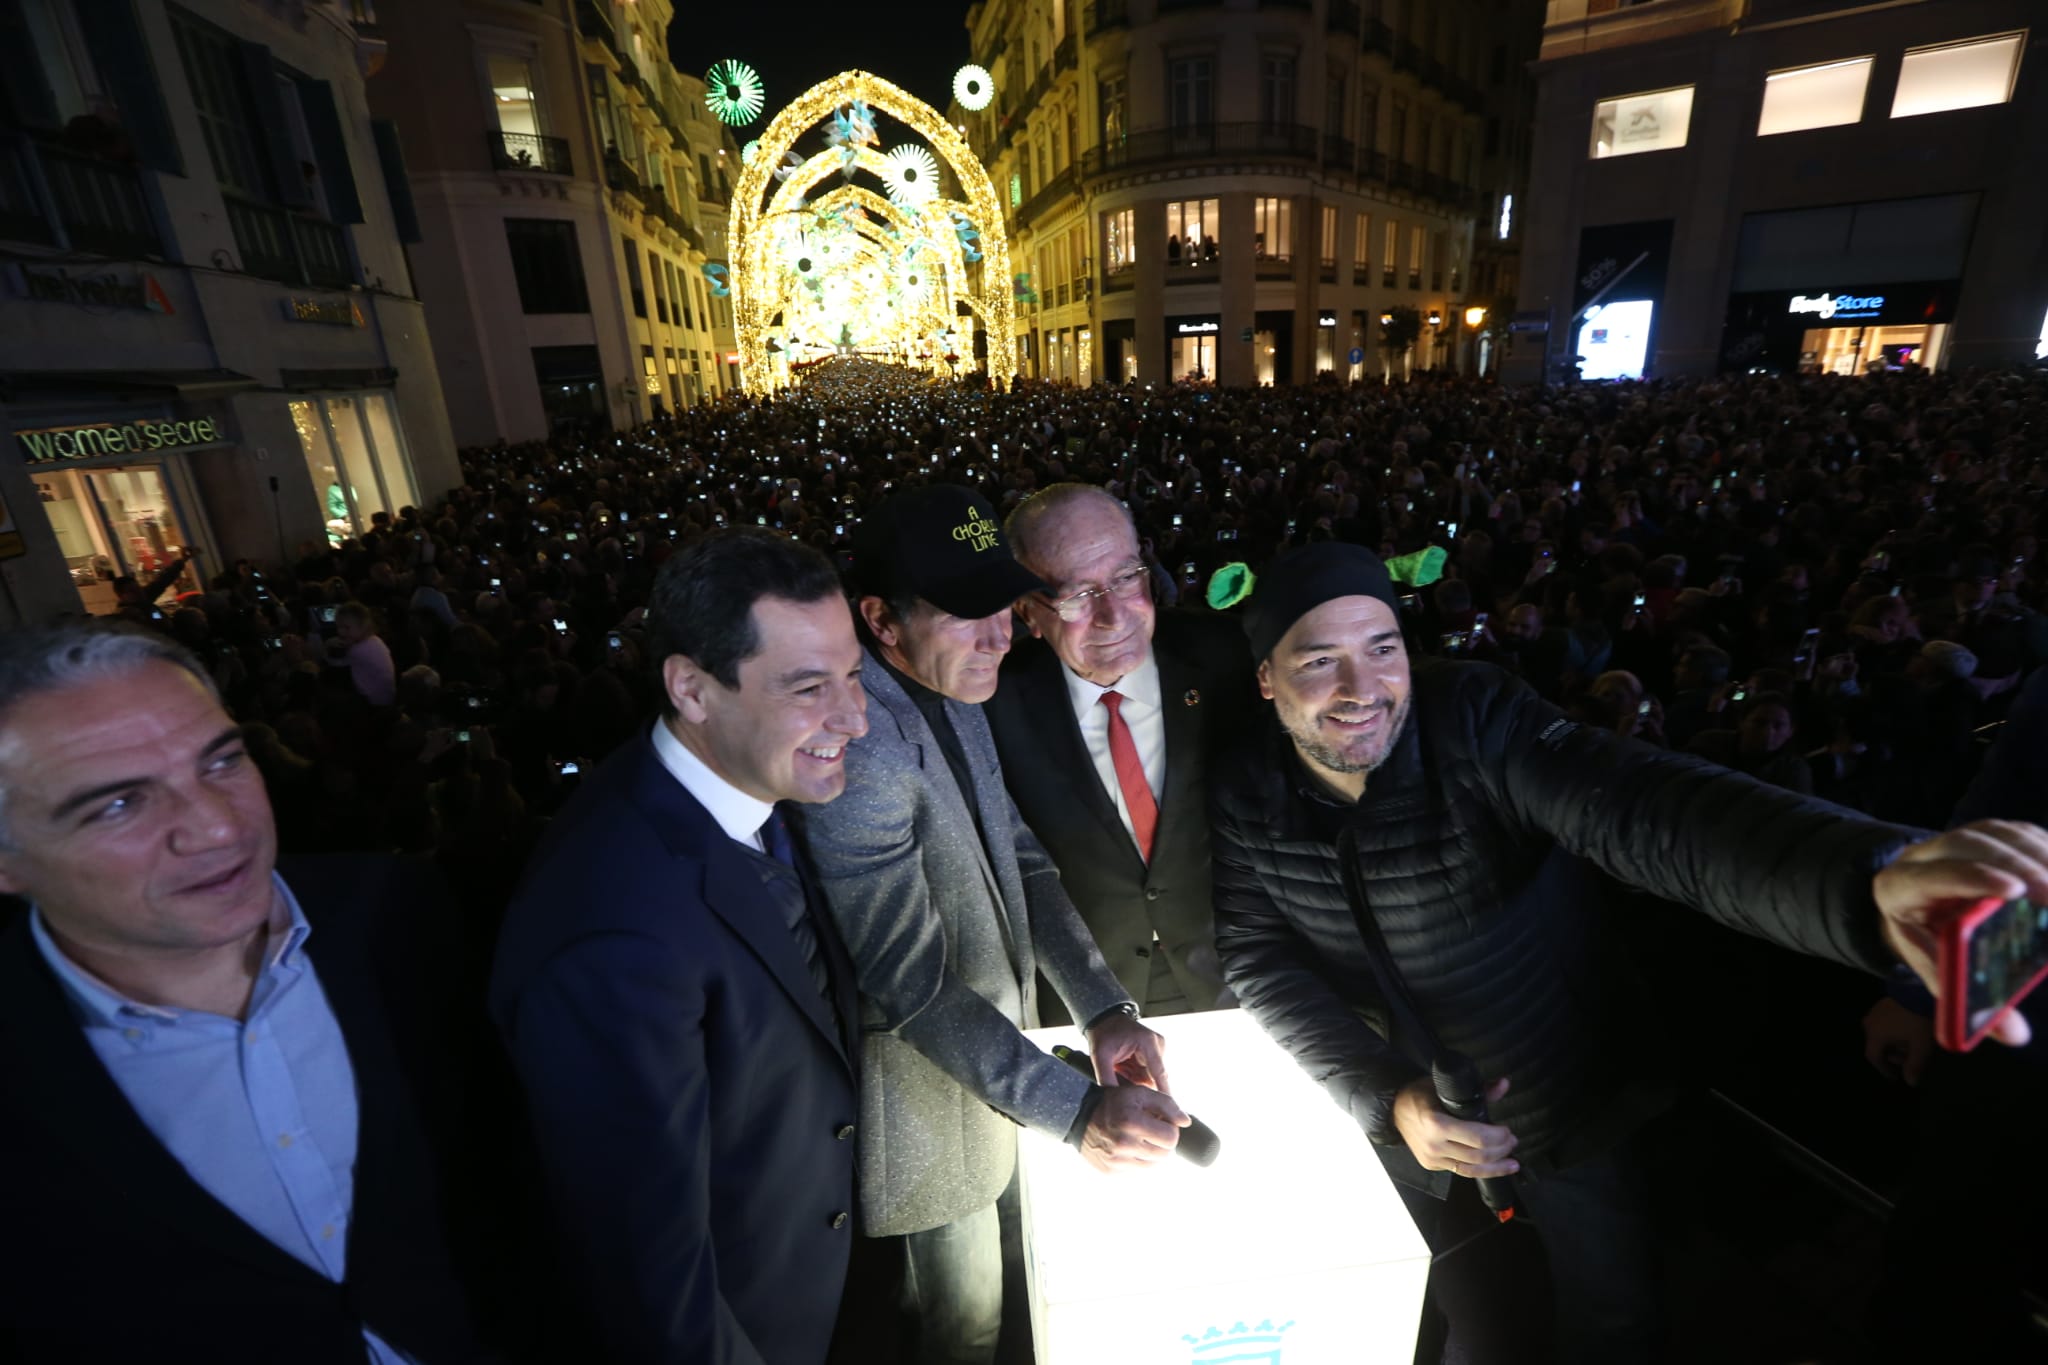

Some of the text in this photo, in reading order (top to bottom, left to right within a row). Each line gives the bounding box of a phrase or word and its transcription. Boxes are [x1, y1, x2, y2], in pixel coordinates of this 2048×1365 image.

[20, 415, 224, 460] women'secret
[968, 505, 980, 520] A
[952, 519, 998, 540] CHOR
[971, 533, 999, 552] LINE
